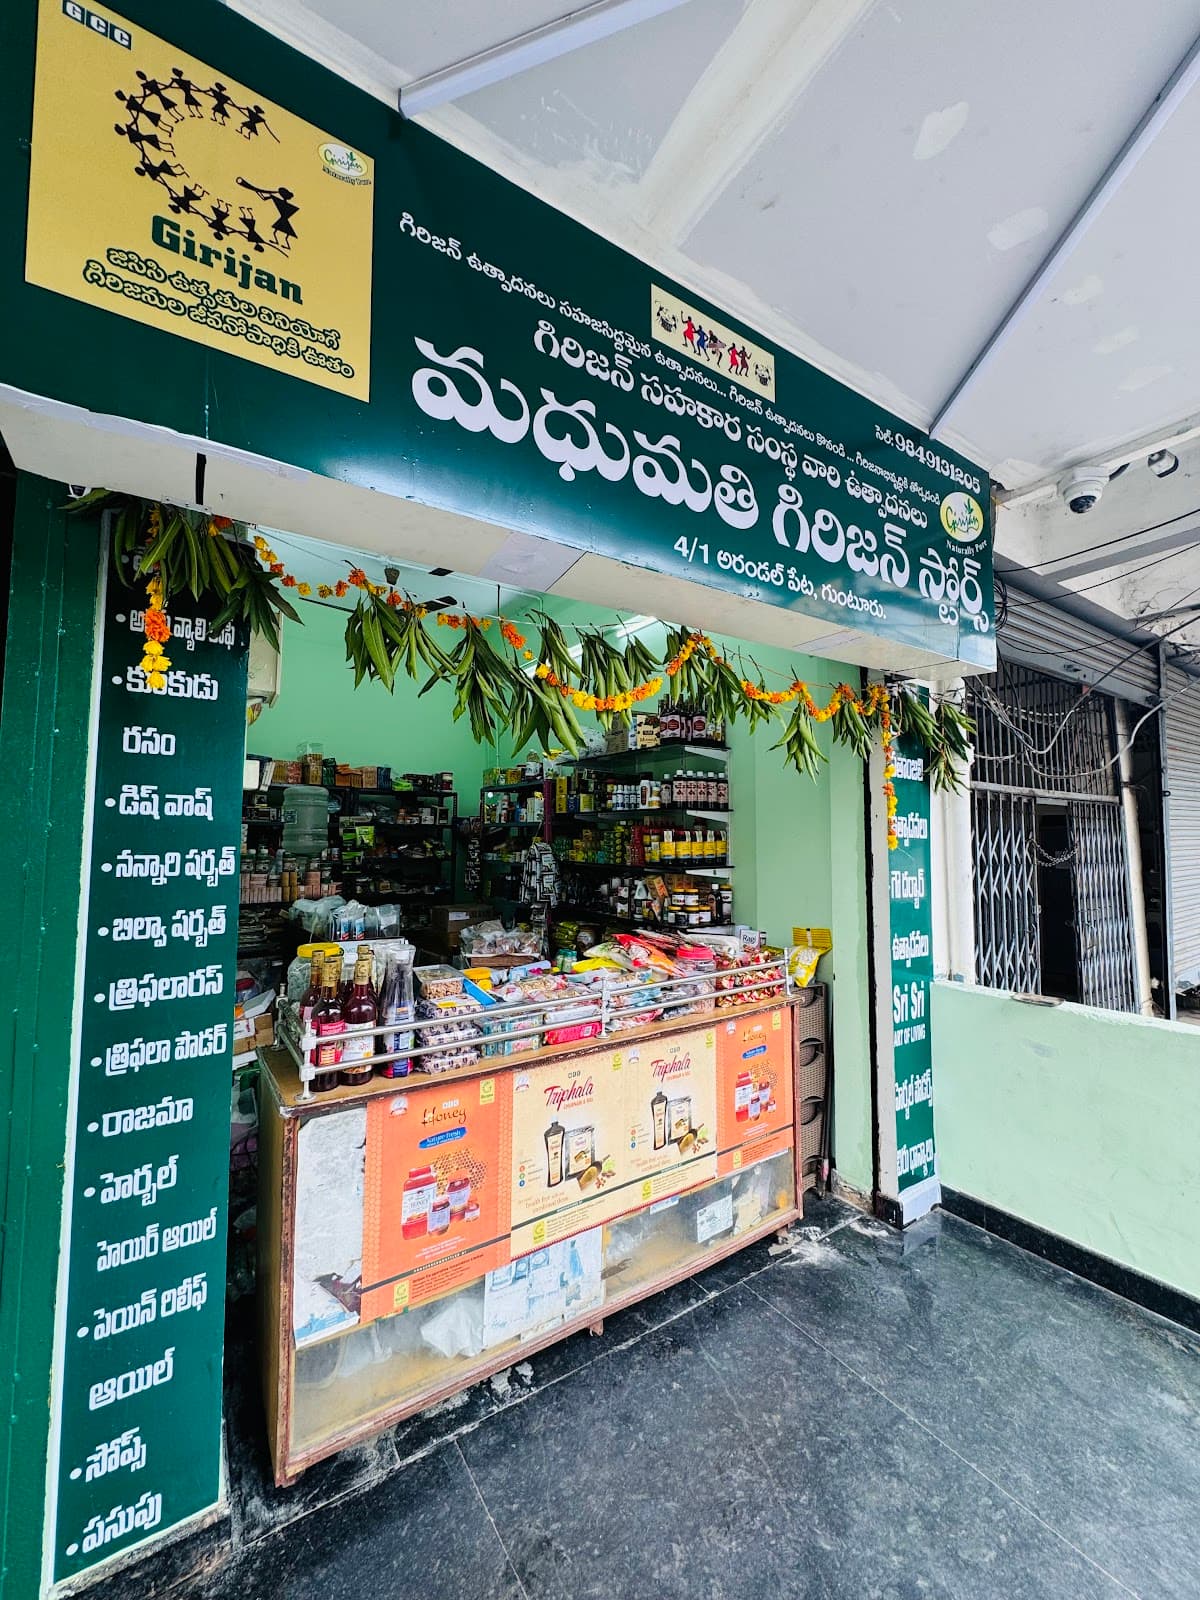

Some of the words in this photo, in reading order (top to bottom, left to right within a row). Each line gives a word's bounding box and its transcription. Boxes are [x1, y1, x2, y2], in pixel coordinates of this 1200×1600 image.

[65, 0, 130, 47] GCC
[106, 247, 167, 283] జిసిసి
[151, 214, 304, 306] Girijan
[399, 210, 462, 261] గిరిజన్
[466, 252, 556, 309] ఉత్పాదనలు
[83, 259, 187, 316] గిరిజనుల
[187, 304, 300, 358] జీవనోపాధికి
[533, 319, 635, 393] గిరిజన్
[640, 372, 742, 442] సహకార
[746, 424, 799, 482] సంస్థ
[802, 453, 841, 488] వారి
[844, 470, 929, 529] ఉత్పాదనలు
[411, 335, 759, 530] మధుమతి
[772, 483, 911, 588] గిరిజన్
[919, 547, 990, 634] స్టోర్స్
[894, 431, 982, 495] 9849131205
[673, 534, 710, 565] 4/1
[716, 549, 785, 586] అరండల్
[122, 725, 176, 757] రసం
[118, 784, 161, 820] డిష్
[164, 787, 215, 821] వాష్
[115, 848, 182, 886] నన్నారి
[184, 846, 237, 888] షర్బత్
[112, 915, 167, 948] బిల్వా
[171, 904, 228, 948] షర్బత్
[108, 964, 224, 1012] త్రిఫలారస్
[893, 983, 909, 1024] Sri
[910, 980, 925, 1020] Sri
[104, 1036, 171, 1077] త్రిఫలా
[174, 1023, 228, 1061] పౌడర్
[904, 1026, 911, 1045] OF
[911, 1023, 926, 1043] LIVING
[543, 1075, 594, 1112] Triphala
[651, 1052, 692, 1083] Triphala
[101, 1095, 194, 1138] రాజమా
[420, 1106, 467, 1127] Honey
[99, 1154, 180, 1207] హెర్బల్
[96, 1222, 160, 1272] హెయిర్
[161, 1206, 218, 1253] ఆయిల్
[92, 1287, 158, 1341] పెయిన్
[160, 1272, 208, 1319] రిలీఫ్
[88, 1345, 176, 1412] ఆయిల్
[85, 1426, 147, 1484] సోప్స్
[81, 1490, 163, 1554] పసుపు
